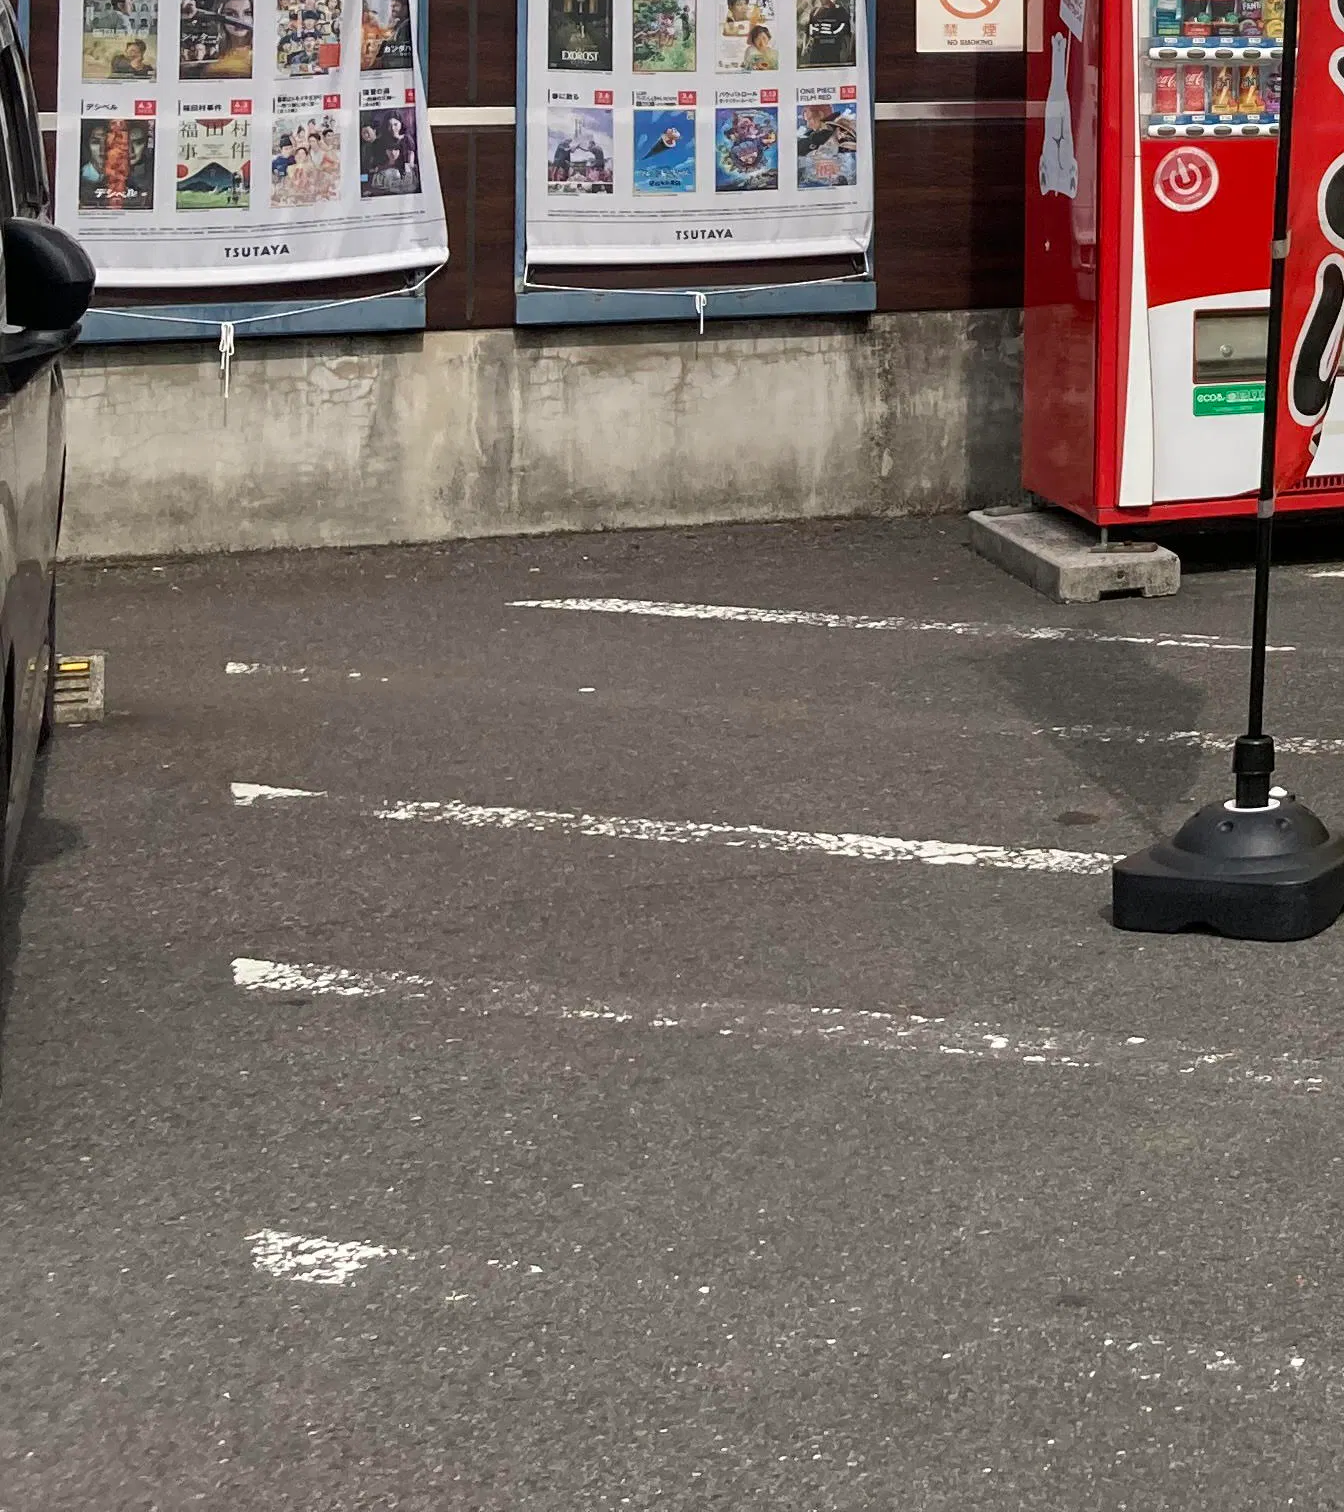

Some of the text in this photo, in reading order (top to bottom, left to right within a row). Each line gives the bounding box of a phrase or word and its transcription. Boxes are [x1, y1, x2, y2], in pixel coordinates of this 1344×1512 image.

[809, 23, 845, 35] ドミノ
[675, 228, 733, 240] TSUTAYA
[224, 244, 290, 259] TSUTAYA
